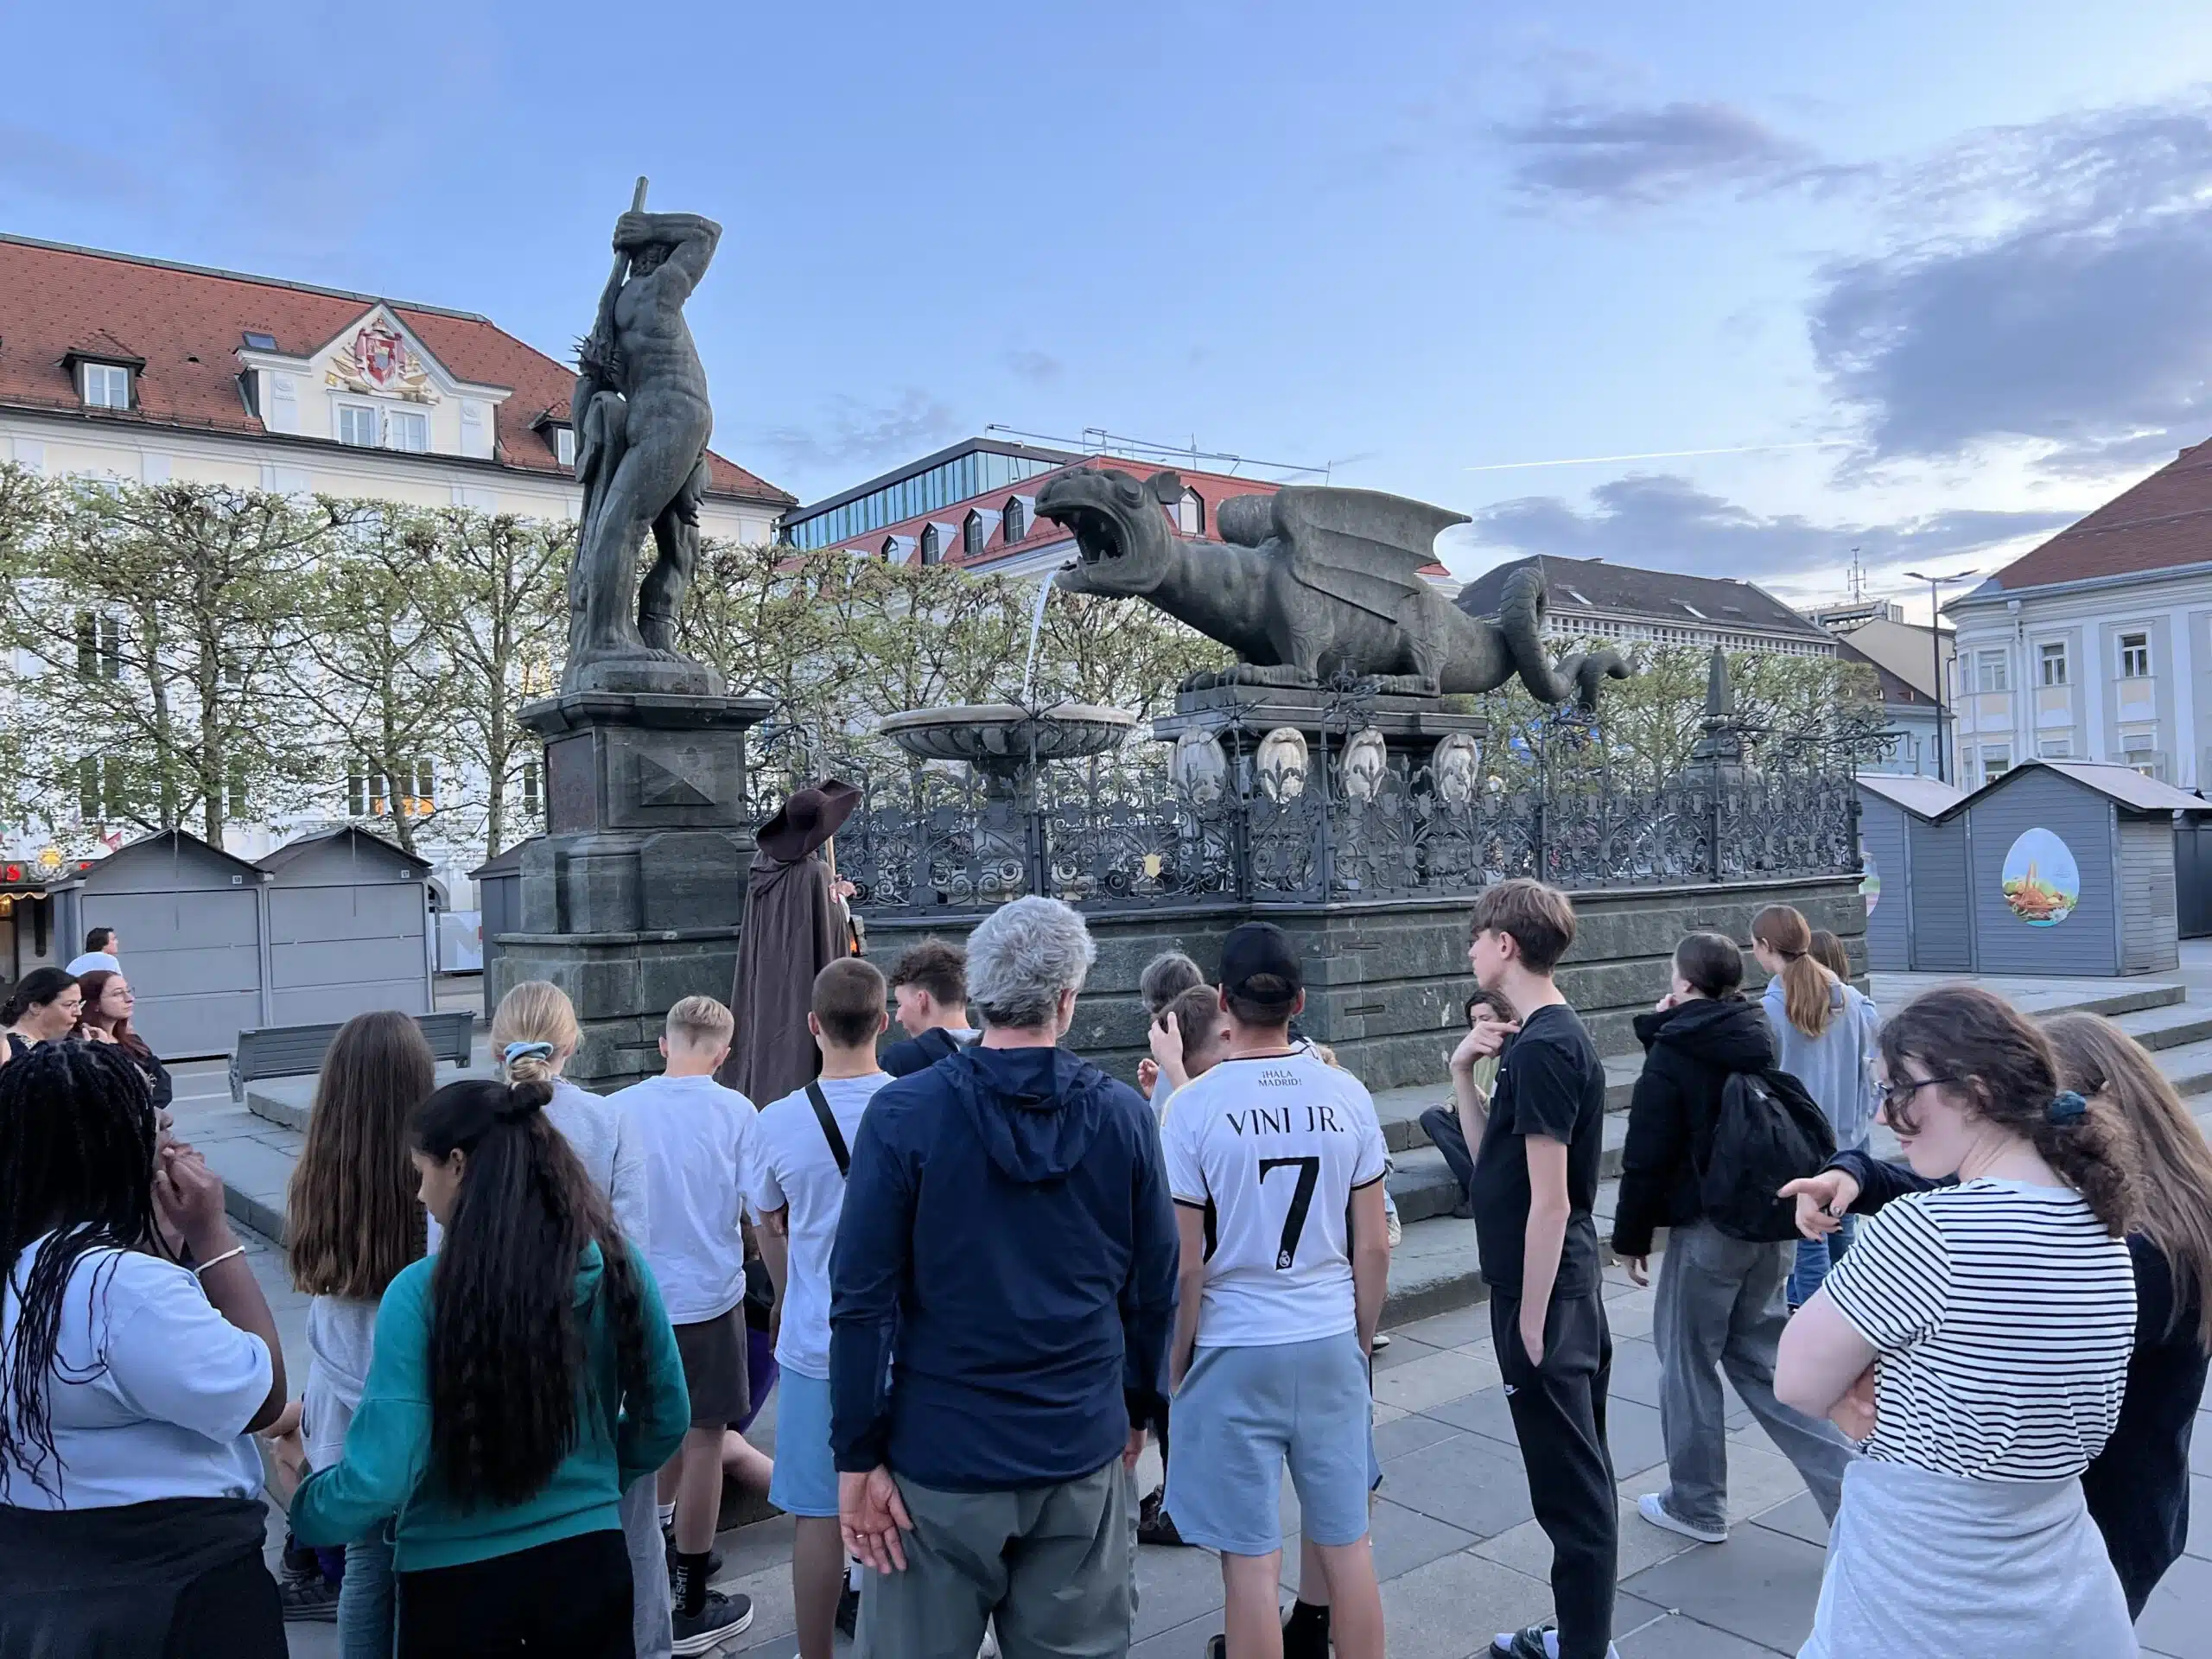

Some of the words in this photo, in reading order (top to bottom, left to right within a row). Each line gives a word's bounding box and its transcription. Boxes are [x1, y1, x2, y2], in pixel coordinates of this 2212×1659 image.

[1258, 1078, 1303, 1087] MADRID!
[1226, 1107, 1291, 1137] VINI
[1305, 1106, 1344, 1133] JR.
[1259, 1156, 1320, 1270] 7
